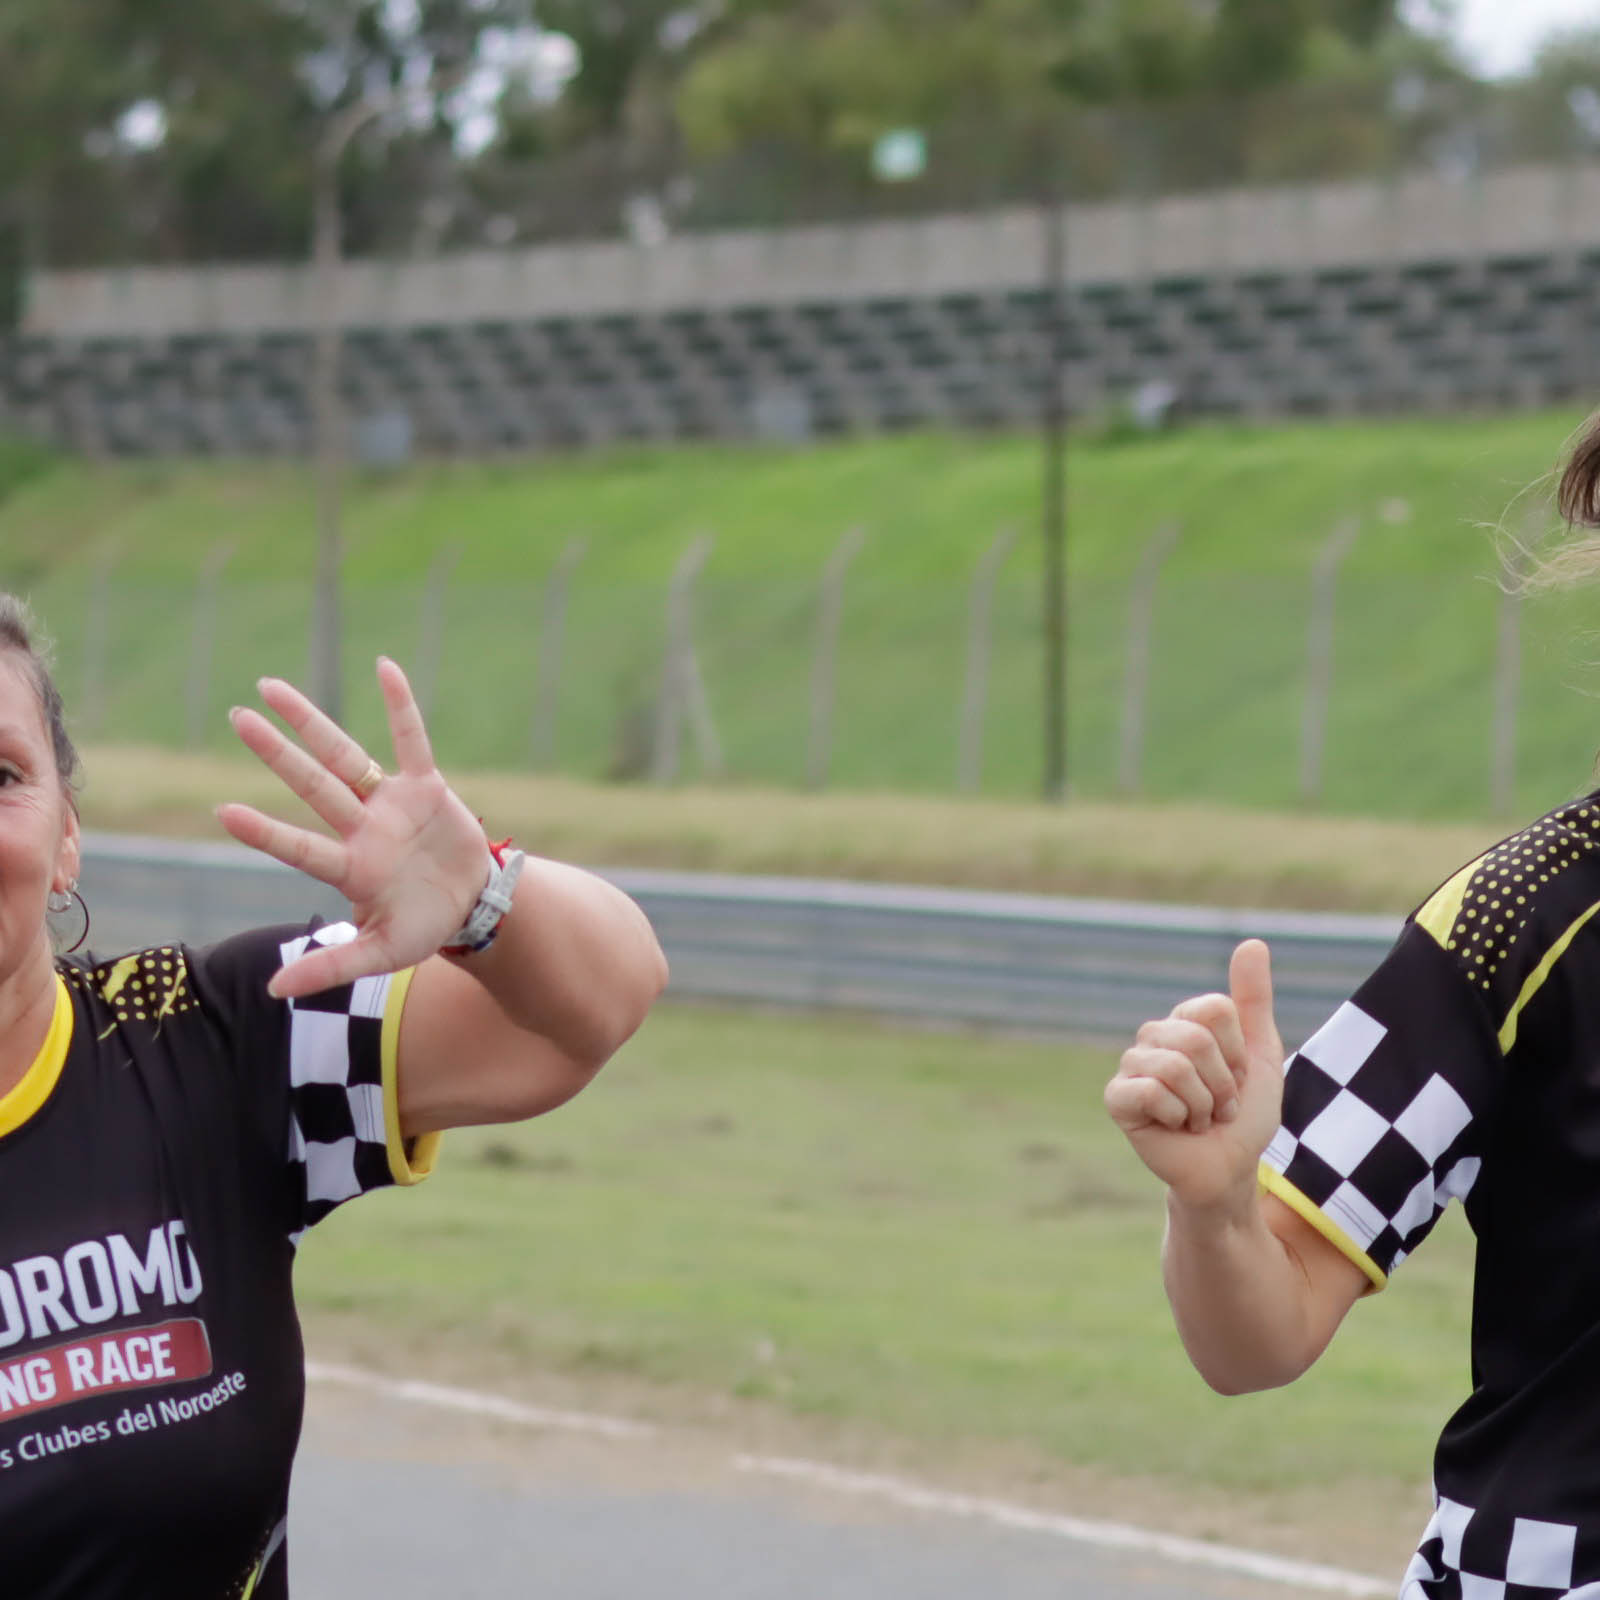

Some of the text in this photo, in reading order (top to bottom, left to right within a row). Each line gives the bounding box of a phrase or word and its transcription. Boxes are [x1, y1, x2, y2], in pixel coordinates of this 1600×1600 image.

[65, 1333, 177, 1391] RACE
[18, 1421, 111, 1463] Clubes
[117, 1408, 157, 1438] del
[161, 1369, 248, 1426] Noroeste
